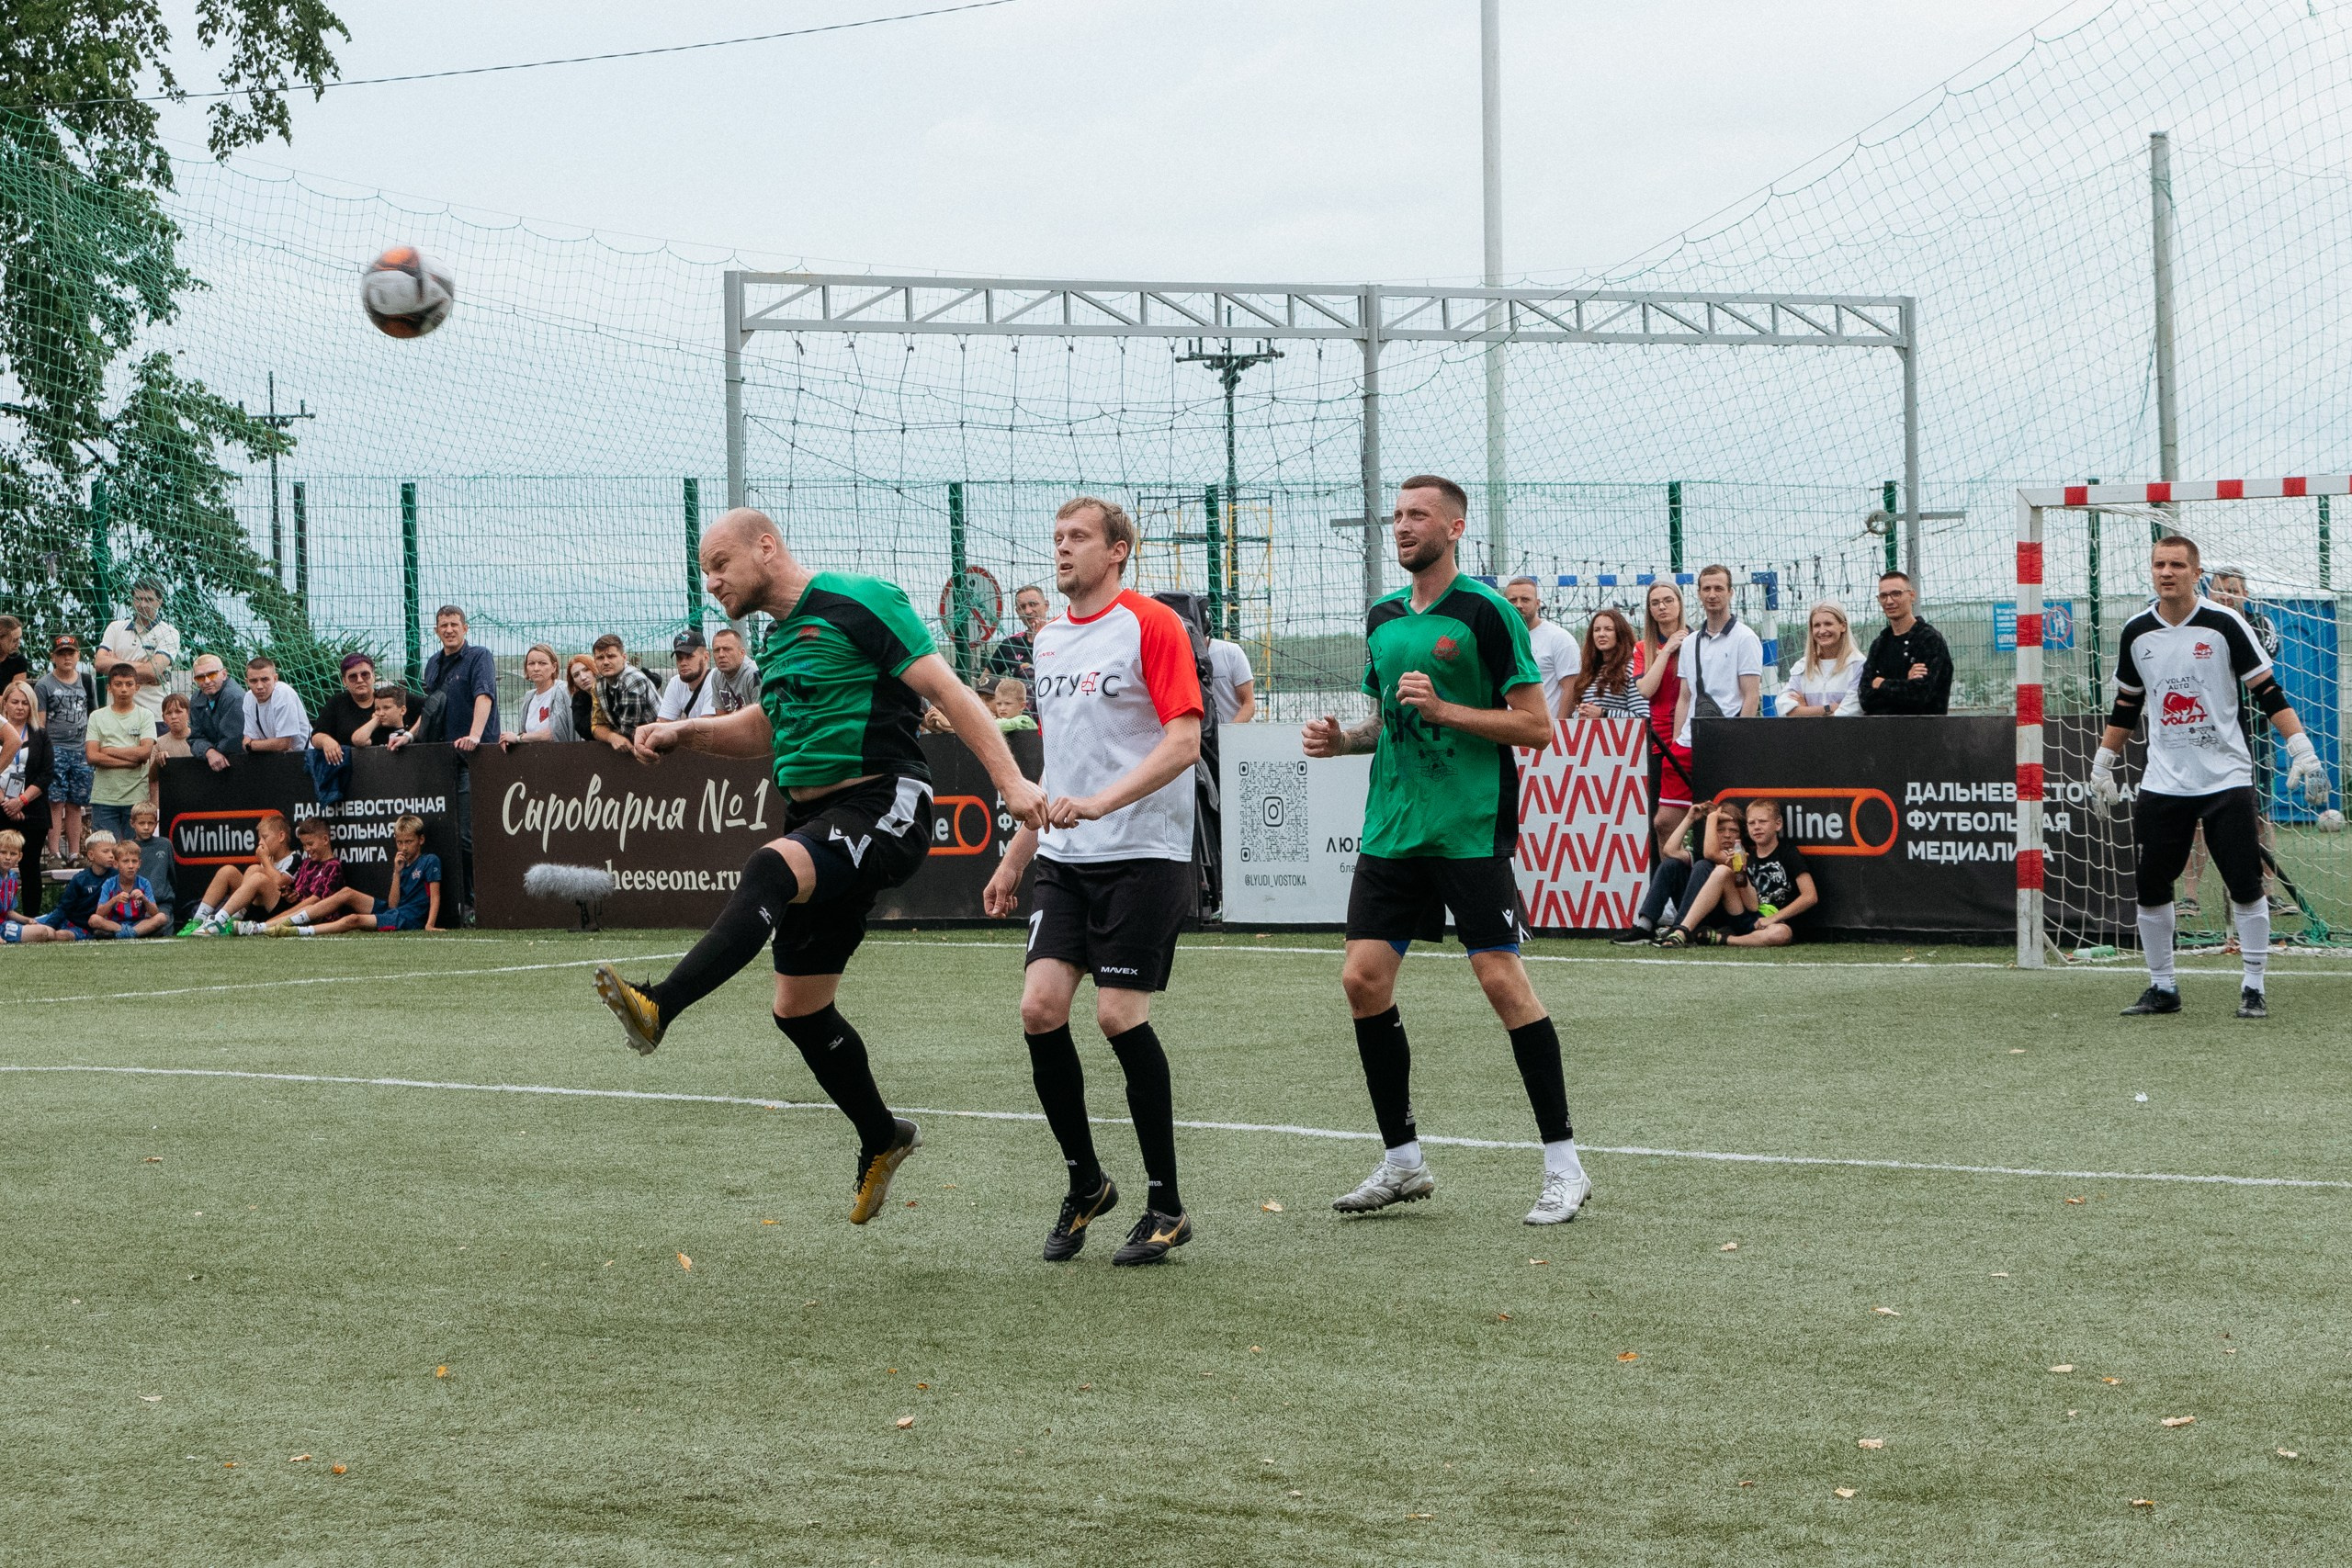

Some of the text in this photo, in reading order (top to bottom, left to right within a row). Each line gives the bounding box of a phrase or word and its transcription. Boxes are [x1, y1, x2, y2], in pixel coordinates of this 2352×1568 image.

[2165, 676, 2190, 684] VOLAT
[503, 773, 687, 853] Сыроварня
[1779, 805, 1843, 840] line
[1905, 809, 2071, 832] ФУТБОЛЬАЯ
[179, 824, 255, 852] Winline
[1907, 840, 2055, 865] МЕДИАЛИА
[605, 859, 742, 891] heeseone.ru
[1244, 874, 1307, 888] @LYUDI_VOSTOKA
[1101, 966, 1138, 976] MAVEX
